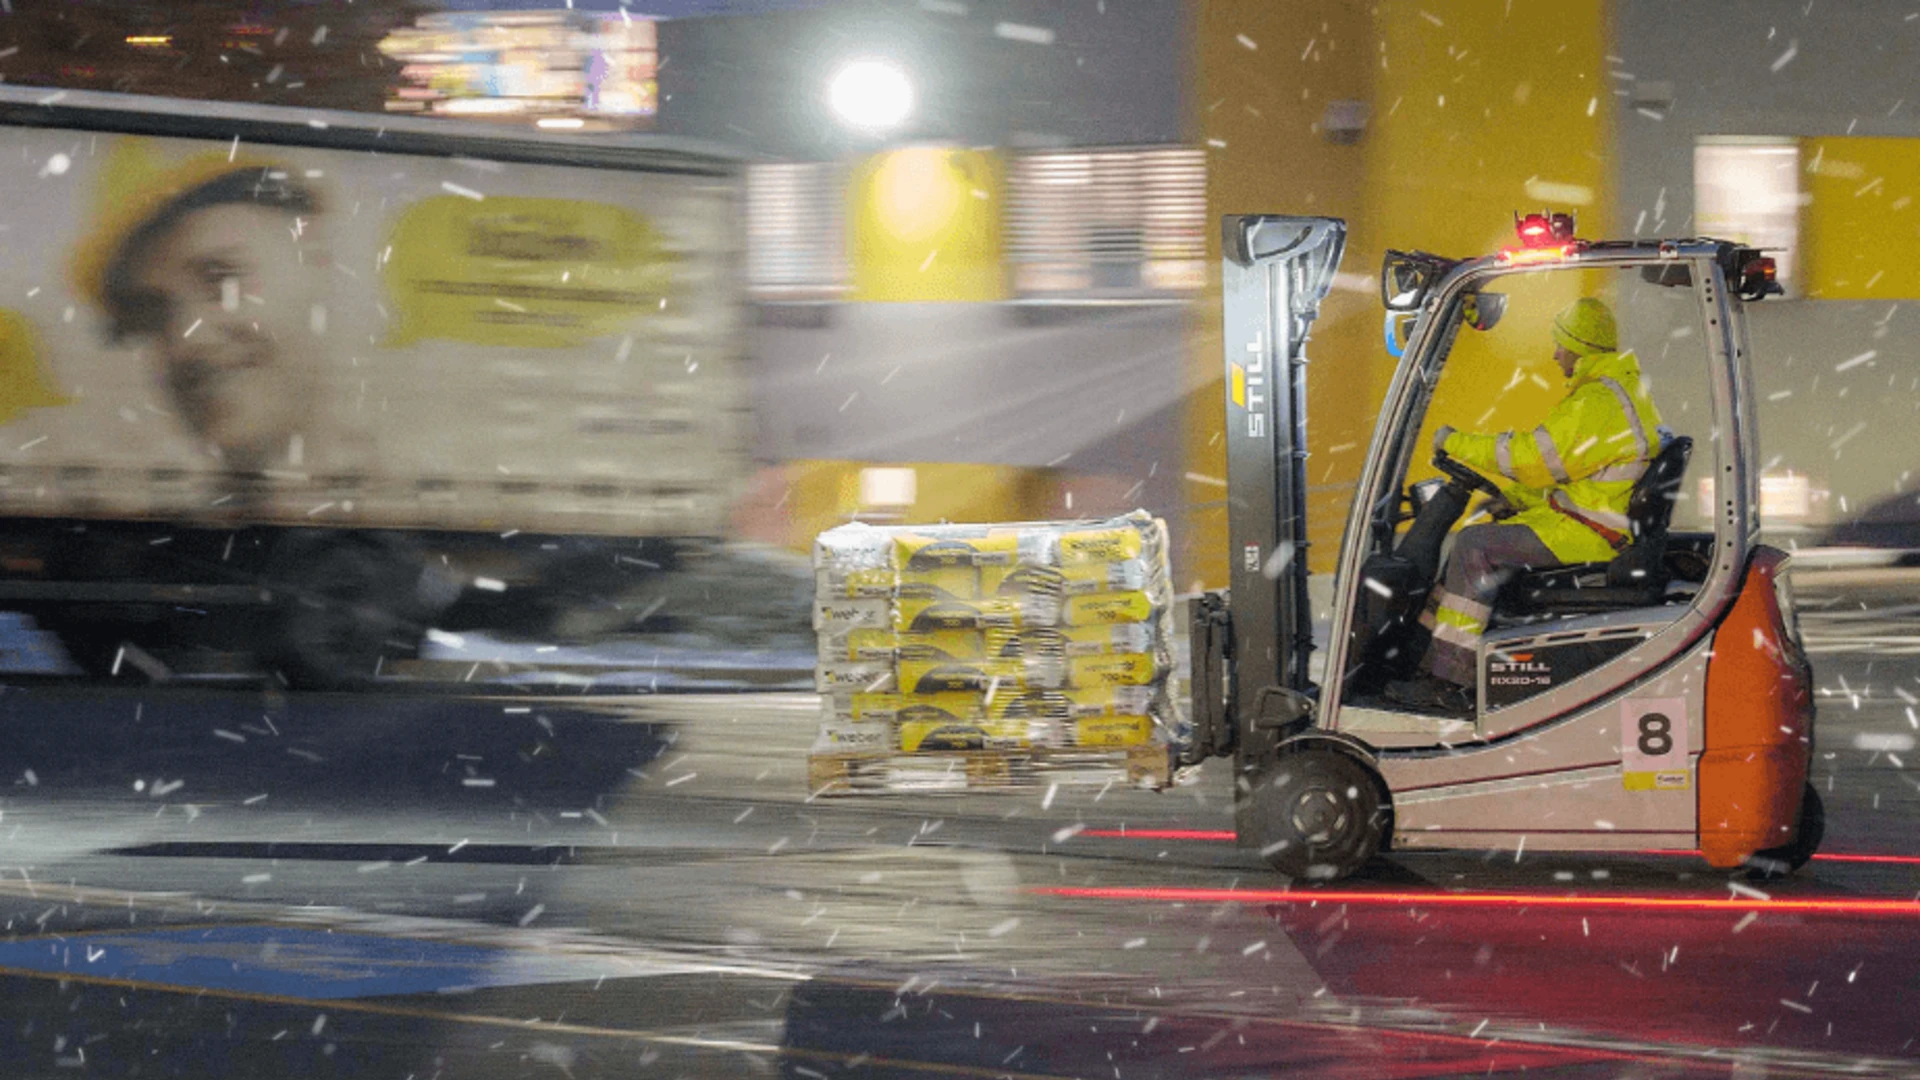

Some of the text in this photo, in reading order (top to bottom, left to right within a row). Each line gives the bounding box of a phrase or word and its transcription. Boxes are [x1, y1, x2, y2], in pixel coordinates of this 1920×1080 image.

[1247, 332, 1264, 437] STILL
[1491, 662, 1551, 672] STILL
[1638, 712, 1673, 755] 8
